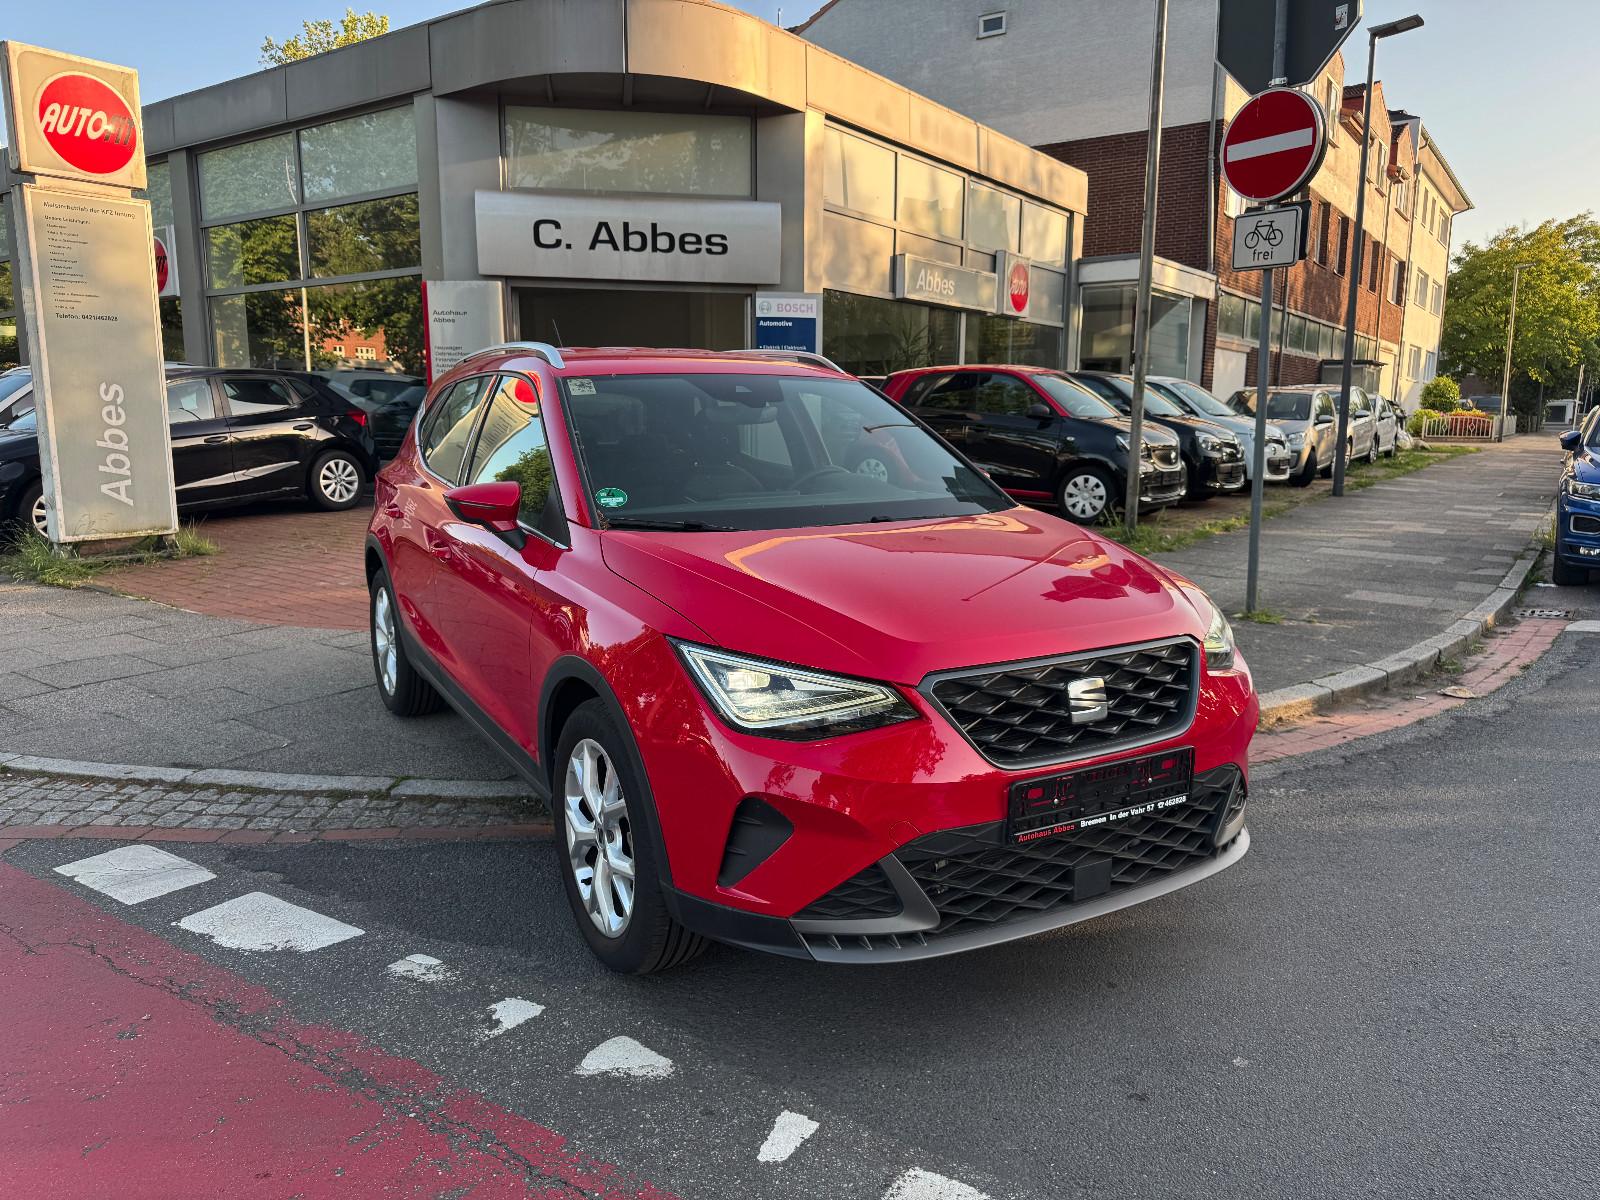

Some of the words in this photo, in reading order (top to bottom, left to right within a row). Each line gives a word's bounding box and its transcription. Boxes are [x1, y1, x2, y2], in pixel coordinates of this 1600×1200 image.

[532, 218, 572, 250] C.
[588, 220, 729, 256] Abbes
[1252, 247, 1274, 262] frei
[916, 268, 956, 296] Abbes
[776, 303, 814, 314] BOSCH
[96, 381, 134, 506] Abbes
[1018, 829, 1052, 843] Autohaus
[1053, 824, 1075, 834] Abbes
[1080, 816, 1107, 828] Bremen
[1109, 813, 1117, 821] In
[1117, 811, 1129, 819] der
[1130, 807, 1146, 816] Vahr
[1146, 803, 1155, 812] 57
